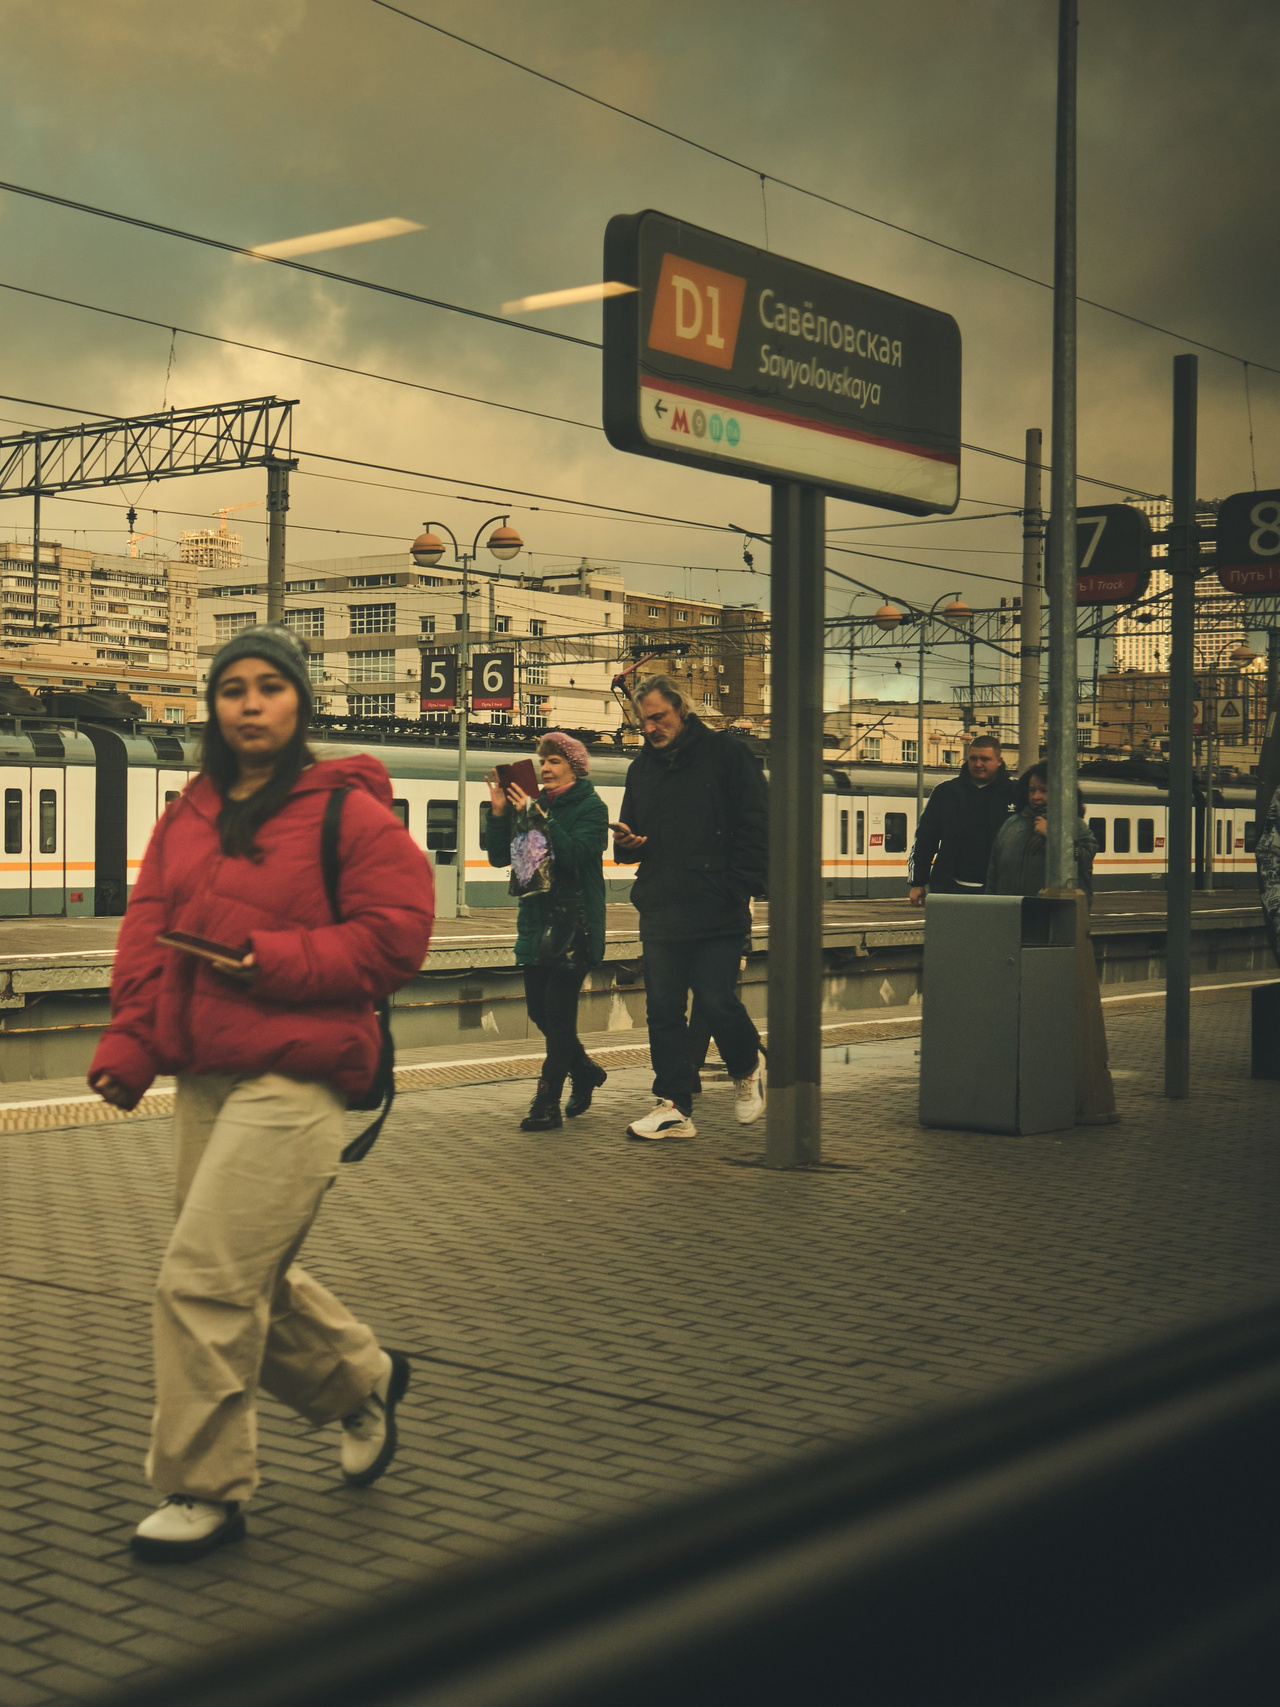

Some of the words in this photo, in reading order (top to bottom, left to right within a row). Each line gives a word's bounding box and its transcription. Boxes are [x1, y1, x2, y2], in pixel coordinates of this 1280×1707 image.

[671, 274, 725, 350] D1
[759, 289, 902, 368] Савёловская
[758, 343, 882, 409] Savyolovskaya
[1076, 515, 1108, 568] 7
[1249, 500, 1280, 556] 8
[1097, 579, 1125, 591] Track
[1230, 570, 1265, 585] Путь
[430, 661, 446, 693] 5
[483, 660, 504, 693] 6
